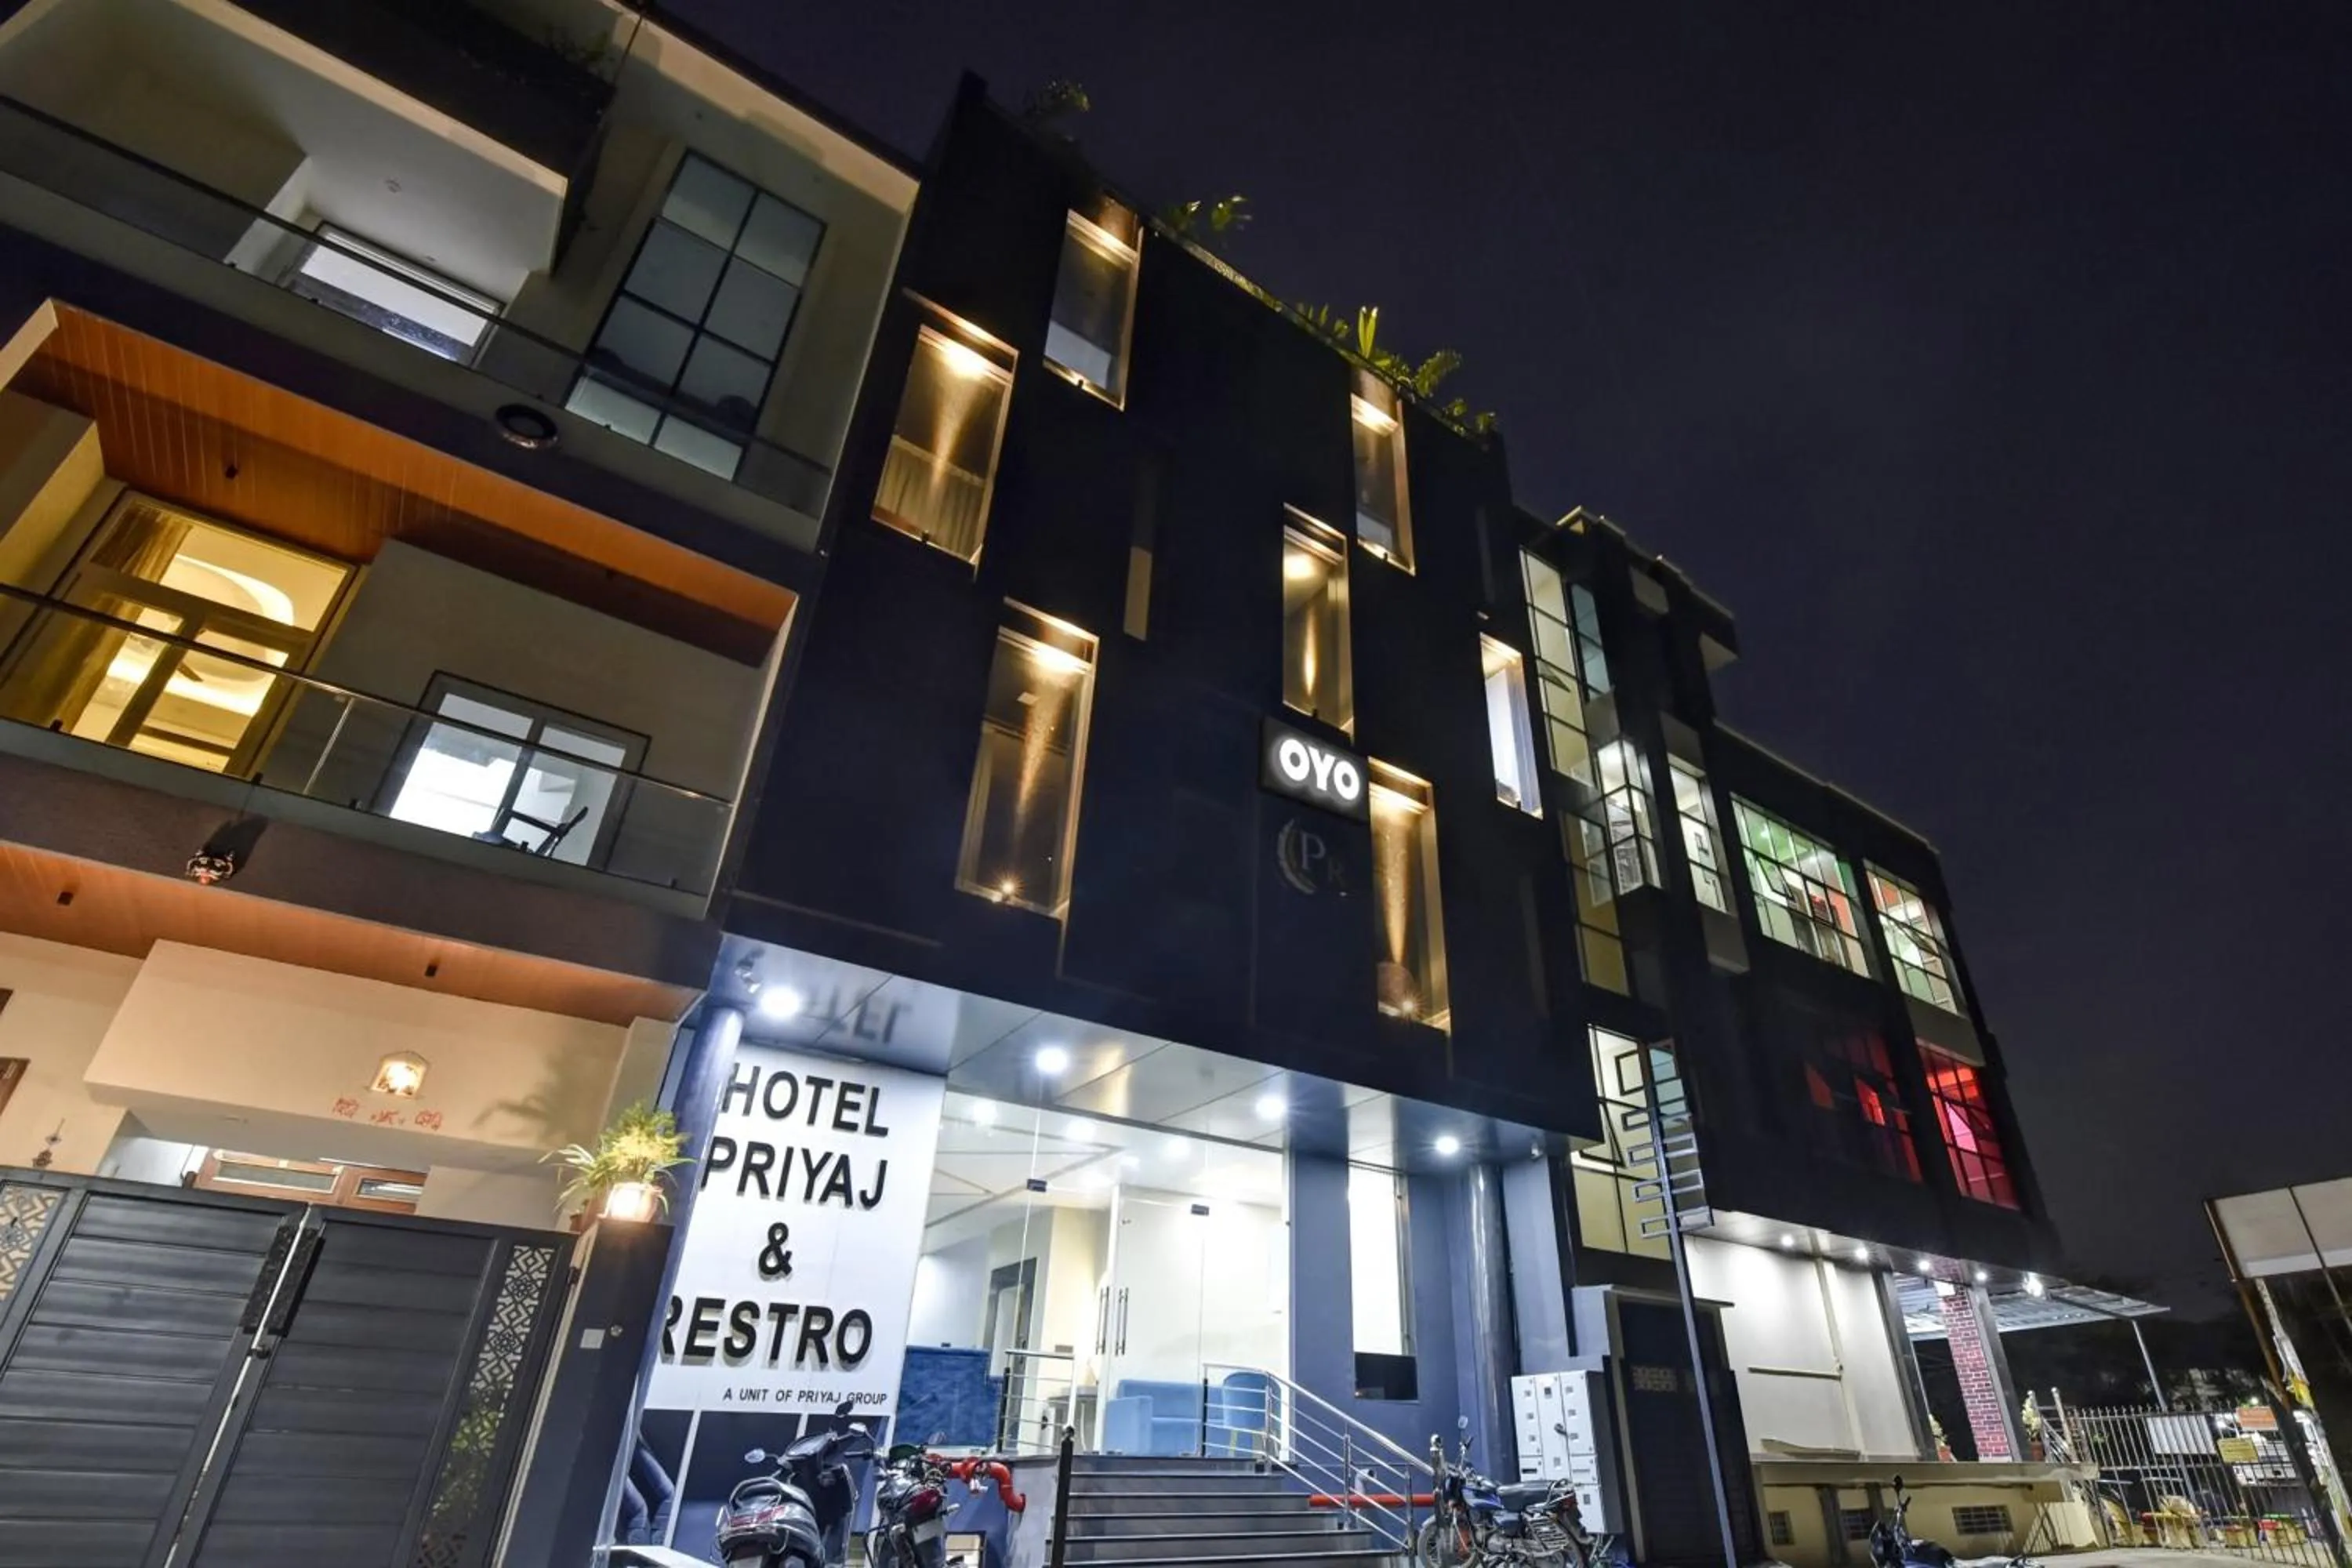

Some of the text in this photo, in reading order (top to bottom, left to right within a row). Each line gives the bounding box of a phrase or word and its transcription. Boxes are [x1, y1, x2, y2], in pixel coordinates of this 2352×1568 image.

[1279, 739, 1360, 800] OYO
[721, 1062, 889, 1137] HOTEL
[700, 1136, 888, 1209] PRIYAJ
[758, 1222, 793, 1278] &
[723, 1388, 887, 1405] A UNIT OF PRIYAJ GROUP
